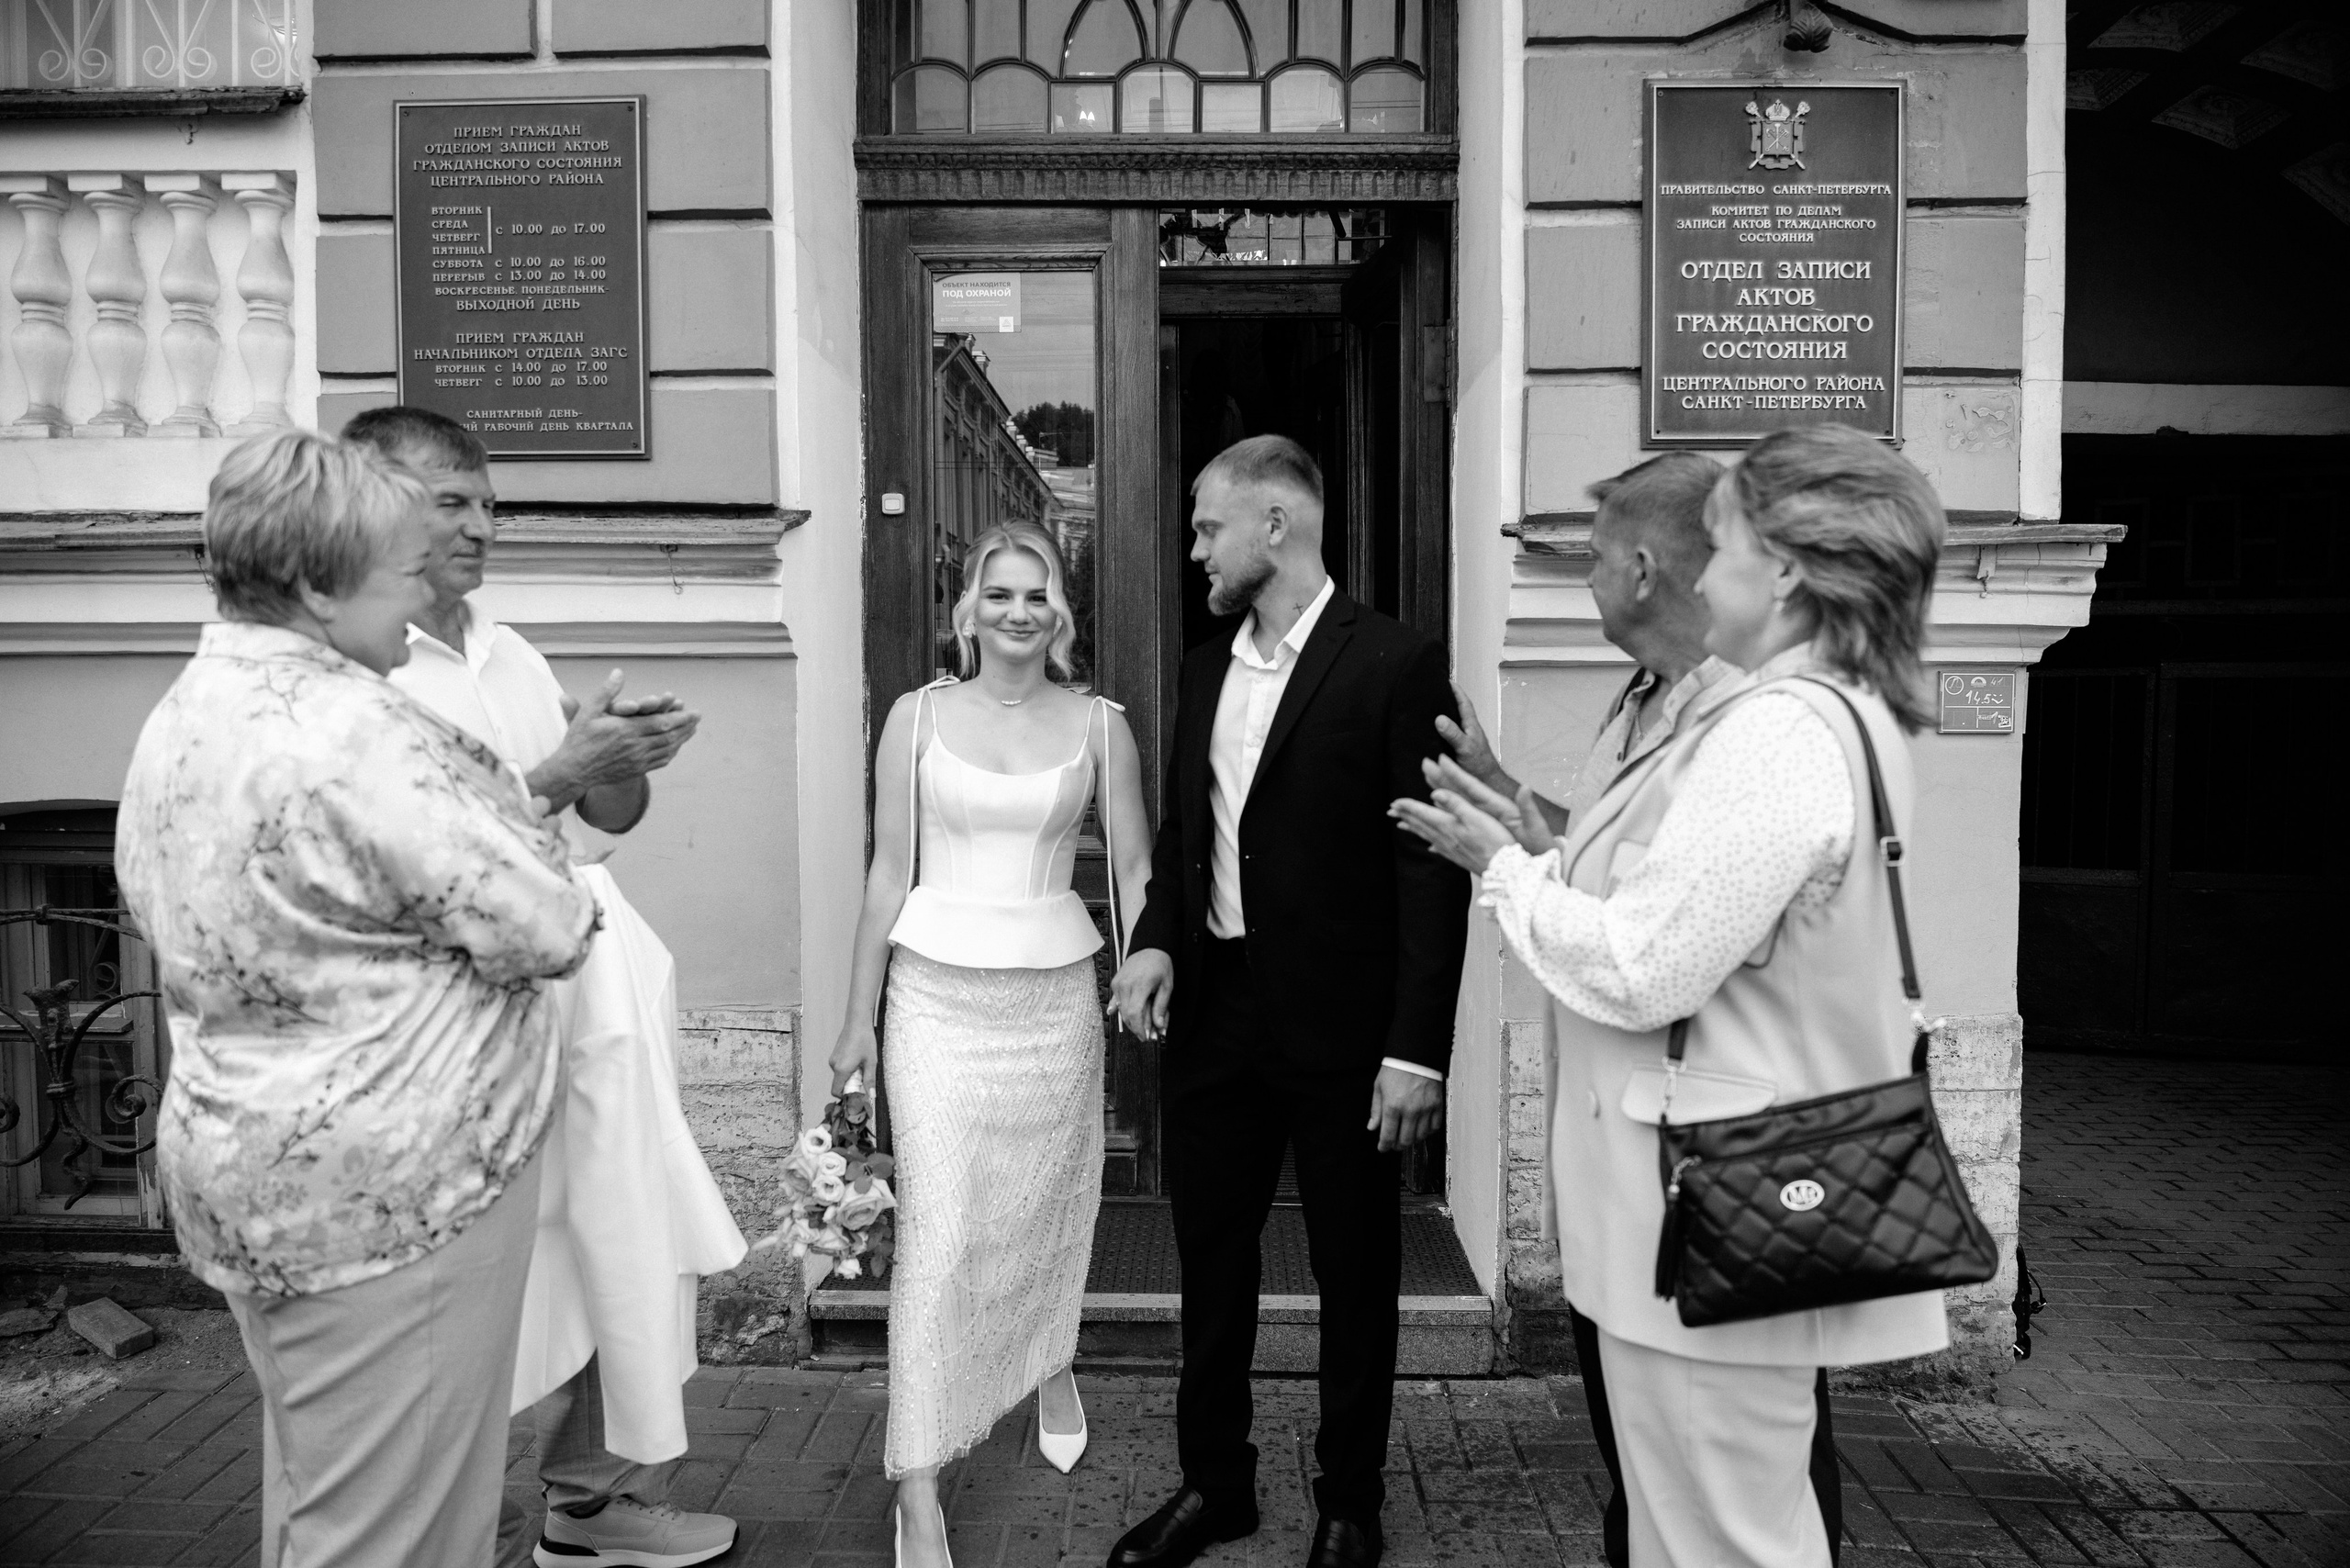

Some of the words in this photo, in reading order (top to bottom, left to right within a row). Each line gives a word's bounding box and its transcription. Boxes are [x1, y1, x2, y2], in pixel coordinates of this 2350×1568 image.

[453, 127, 503, 138] ПРИЕМ
[510, 125, 581, 137] ГРАЖДАН
[425, 143, 492, 155] ОТДЕЛОМ
[500, 142, 556, 152] ЗАПИСИ
[564, 140, 610, 151] АКТОВ
[413, 159, 530, 172] ГРАЖДАНСКОГО
[536, 157, 622, 169] СОСТОЯНИЯ
[431, 174, 541, 187] ЦЕНТРАЛЬНОГО
[549, 173, 604, 185] РАЙОНА
[1661, 185, 1764, 196] ПРАВИТЕЛЬСТВО
[1773, 185, 1891, 196] САНКТ-ПЕТЕРБУРГА
[431, 207, 482, 215] ВТОРНИК
[1711, 206, 1769, 216] КОМИТЕТ
[1776, 206, 1792, 216] ПО
[1797, 206, 1841, 218] ДЕЛАМ
[431, 220, 468, 230] СРЕДА
[511, 224, 543, 234] 10.00
[574, 224, 606, 234] 17.00
[1676, 219, 1726, 230] ЗАПИСИ
[1733, 219, 1772, 229] АКТОВ
[1778, 219, 1875, 230] ГРАЖДАНСКОГО
[432, 233, 481, 242] ЧЕТВЕРГ
[1739, 232, 1813, 242] СОСТОЯНИЯ
[432, 246, 486, 256] ПЯТНИЦА
[432, 260, 484, 269] СУББОТА
[510, 257, 542, 267] 10.00
[574, 256, 606, 266] 16.00
[433, 273, 486, 282] ПЕРЕРЫВ
[510, 271, 542, 281] 13.00
[574, 270, 606, 280] 14.00
[1681, 262, 1763, 282] ОТДЕЛ
[1777, 262, 1871, 279] ЗАПИСИ
[943, 289, 963, 298] ПОД
[966, 287, 1012, 297] ОХРАНОЙ
[1737, 288, 1815, 306] АКТОВ
[456, 297, 534, 312] ВЫХОДНОЙ
[543, 299, 580, 311] ДЕНЬ
[1676, 315, 1874, 335] ГРАЖДАНСКОГО
[456, 333, 504, 344] ПРИЕМ
[513, 331, 584, 343] ГРАЖДАН
[414, 349, 518, 361] НАЧАЛЬНИКОМ
[526, 349, 583, 359] ОТДЕЛА
[591, 347, 628, 358] ЗАГС
[1702, 342, 1847, 359] СОСТОЯНИЯ
[435, 364, 486, 374] ВТОРНИК
[511, 363, 541, 373] 14.00
[576, 362, 607, 372] 17.00
[435, 378, 482, 387] ЧЕТВЕРГ
[512, 376, 541, 386] 10.00
[576, 375, 608, 386] 13.00
[1662, 377, 1807, 392] ЦЕНТРАЛЬНОГО
[1816, 375, 1885, 391] РАЙОНА
[466, 408, 543, 419] САНИТАРНЫЙ
[485, 420, 534, 432] РАБОЧИЙ
[540, 422, 569, 432] ДЕНЬ
[576, 422, 633, 431] КВАРТАЛА
